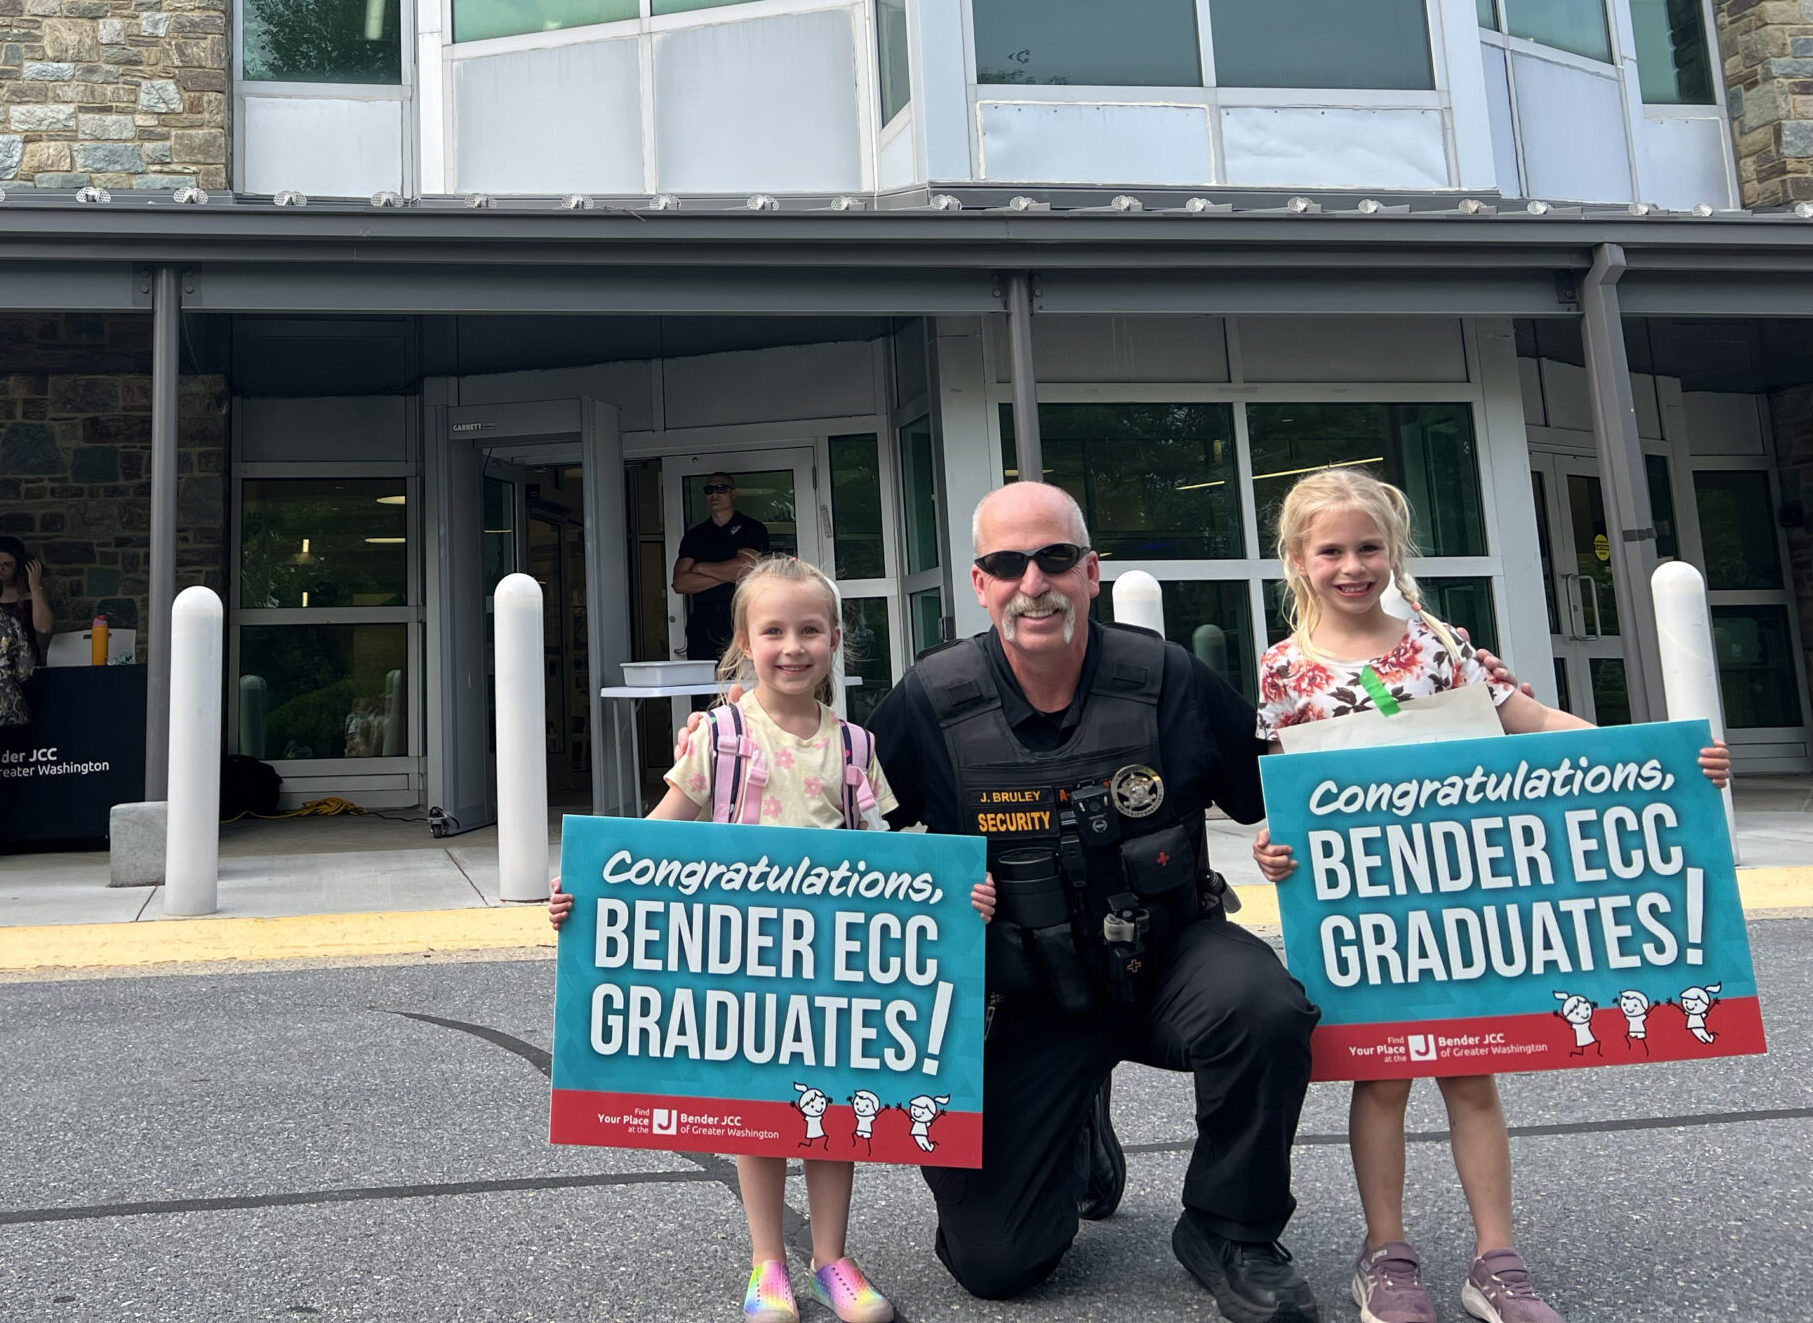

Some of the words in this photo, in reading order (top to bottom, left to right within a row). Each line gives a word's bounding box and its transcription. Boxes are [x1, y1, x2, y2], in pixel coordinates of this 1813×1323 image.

[28, 747, 57, 762] JCC
[38, 761, 110, 775] Washington
[1309, 756, 1676, 817] Congratulations,
[980, 792, 991, 803] J.
[992, 790, 1041, 803] BRULEY
[977, 811, 1051, 833] SECURITY
[1307, 812, 1554, 901] BENDER
[1565, 802, 1684, 883] ECC
[602, 850, 944, 905] Congratulations,
[1319, 867, 1705, 988] GRADUATES!
[594, 897, 816, 980] BENDER
[833, 910, 939, 986] ECC
[589, 981, 954, 1077] GRADUATES!
[1387, 1036, 1404, 1044] Find
[1438, 1035, 1480, 1047] Bender
[1483, 1033, 1505, 1044] JCC
[1349, 1046, 1374, 1056] Your
[1377, 1044, 1405, 1055] Place
[1440, 1048, 1452, 1058] of
[1453, 1046, 1488, 1058] Greater
[1492, 1043, 1548, 1055] Washington
[598, 1113, 621, 1124] Your
[623, 1114, 649, 1126] Place
[634, 1108, 650, 1116] Find
[680, 1113, 719, 1126] Bender
[721, 1116, 742, 1126] JCC
[637, 1126, 649, 1134] the
[680, 1125, 691, 1134] of
[691, 1126, 725, 1137] Greater
[727, 1129, 780, 1140] Washington
